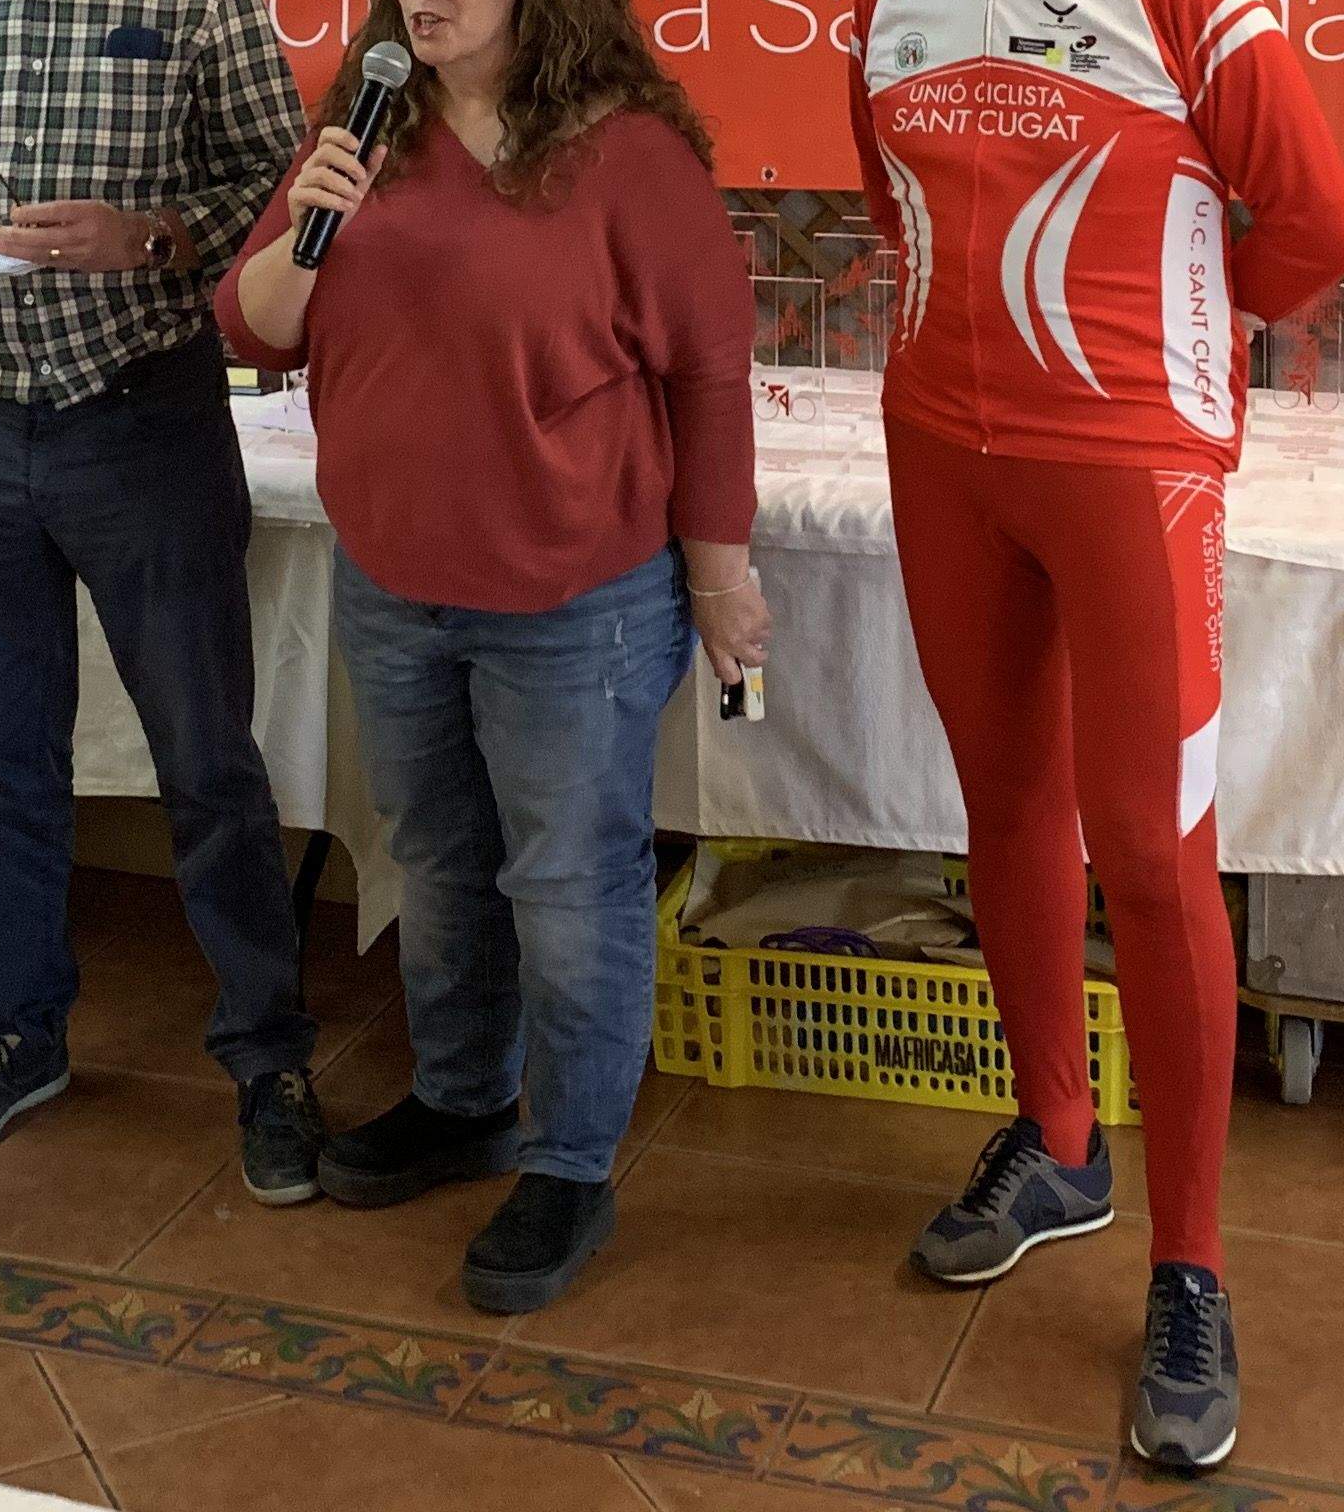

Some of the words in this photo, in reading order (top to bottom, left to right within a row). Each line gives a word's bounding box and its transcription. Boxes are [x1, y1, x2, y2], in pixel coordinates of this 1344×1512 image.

[908, 77, 967, 105] UNIÓ
[973, 80, 1067, 109] CICLISTA
[892, 106, 973, 135] SANT
[977, 108, 1085, 142] CUGAT
[1188, 262, 1209, 331] SANT
[874, 1033, 978, 1078] MAFRICASA
